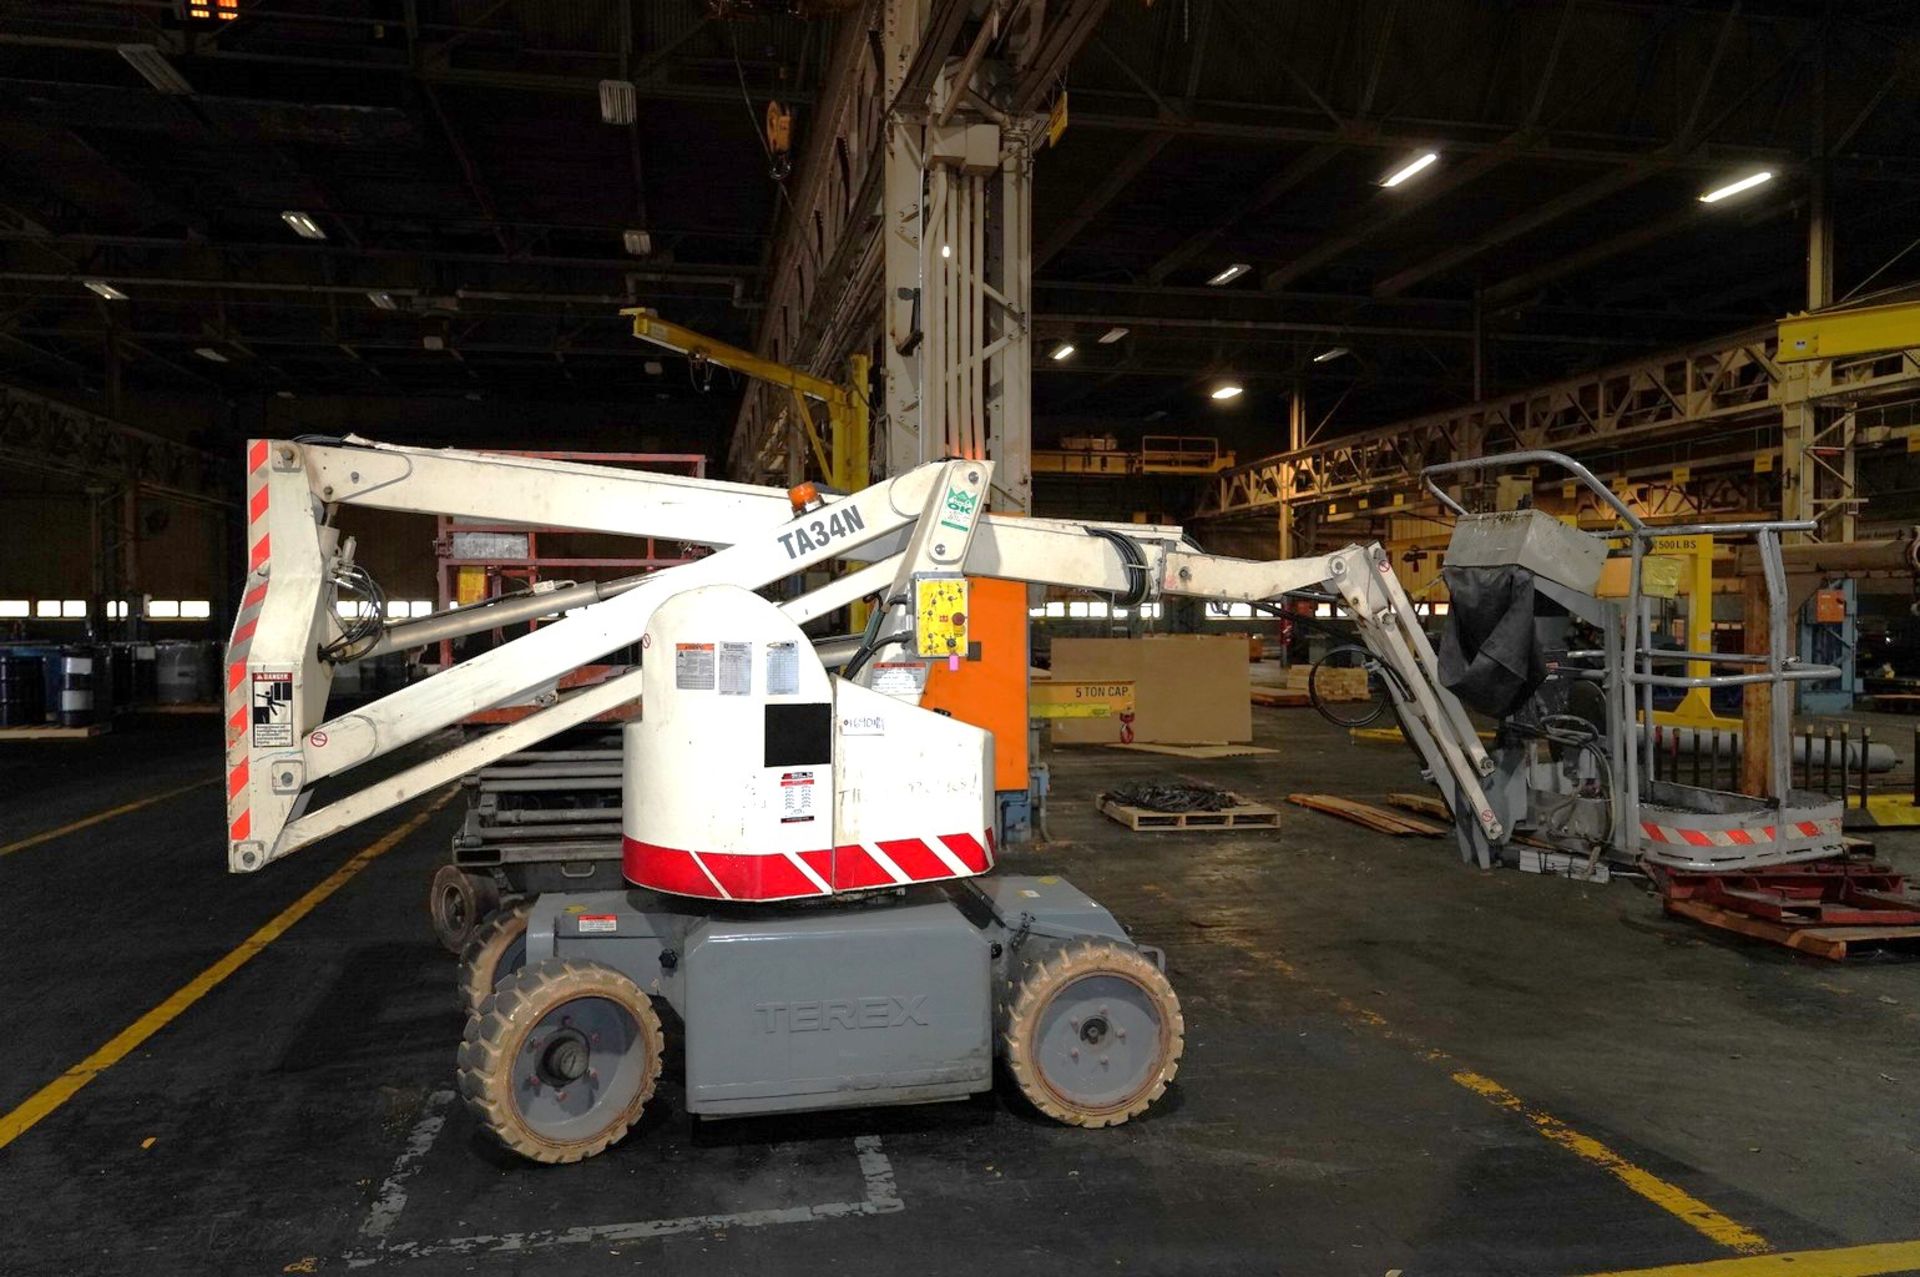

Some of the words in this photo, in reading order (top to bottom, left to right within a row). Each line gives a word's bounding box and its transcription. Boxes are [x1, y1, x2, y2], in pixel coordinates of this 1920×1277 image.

[947, 503, 971, 515] OK
[777, 505, 865, 559] TA34N
[1075, 687, 1082, 698] 5
[1085, 686, 1106, 697] TON
[752, 994, 928, 1034] TEREX
